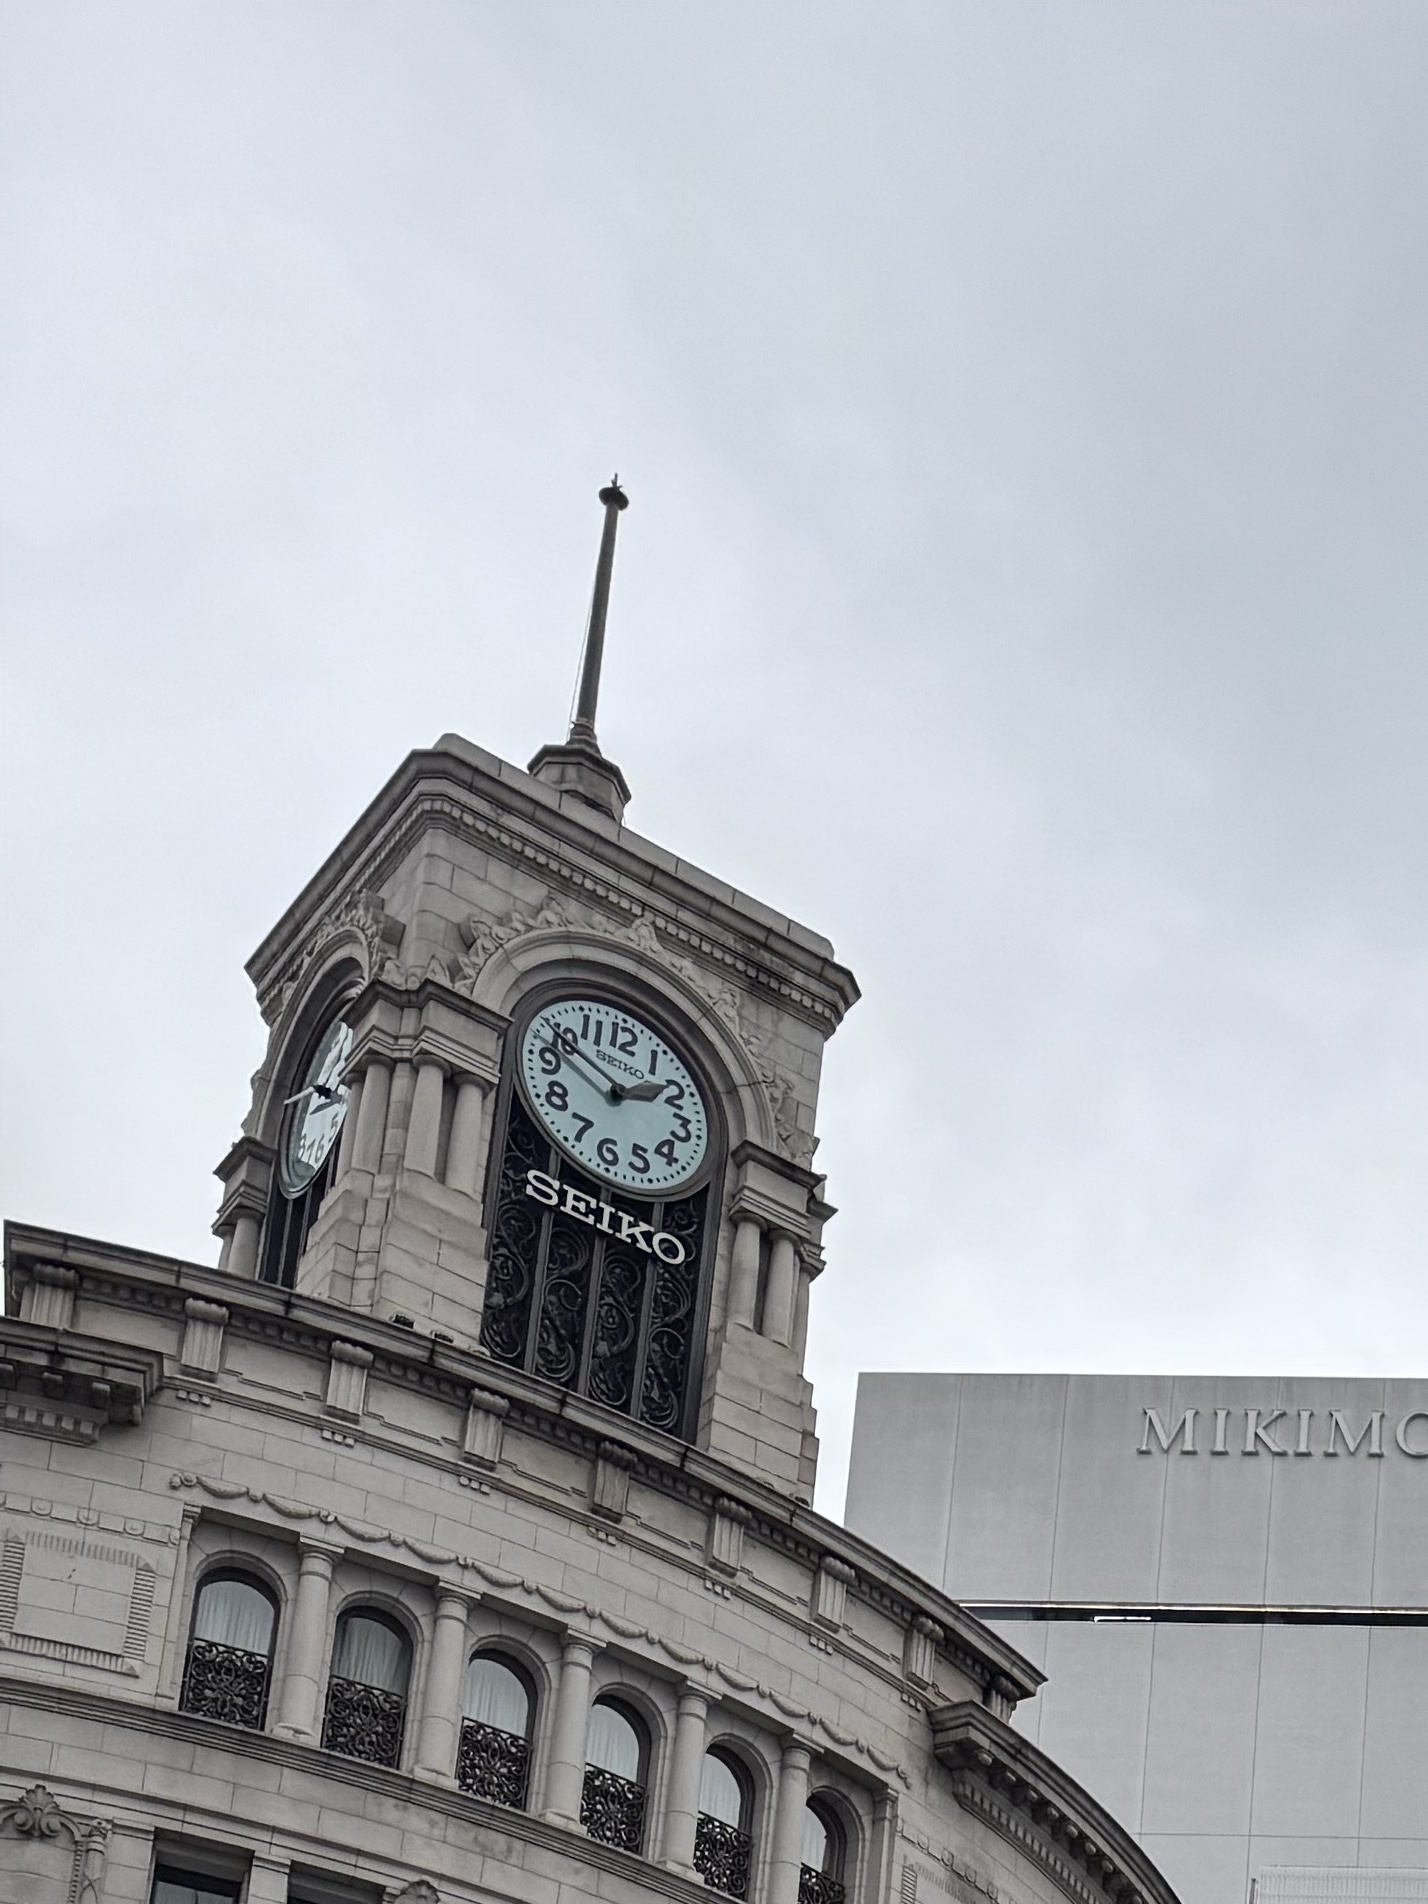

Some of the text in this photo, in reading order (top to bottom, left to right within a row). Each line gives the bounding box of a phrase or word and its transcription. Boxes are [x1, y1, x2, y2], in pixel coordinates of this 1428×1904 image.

[580, 1014, 603, 1048] 11
[609, 1021, 639, 1058] 12
[538, 1046, 562, 1076] 9
[595, 1049, 645, 1081] SEIKO
[648, 1049, 658, 1076] 1
[545, 1080, 569, 1112] 8
[664, 1078, 686, 1111] 2
[572, 1112, 595, 1143] 7
[670, 1112, 692, 1143] 3
[596, 1137, 620, 1167] 6
[628, 1142, 651, 1175] 5
[654, 1138, 679, 1168] 4
[525, 1169, 686, 1266] SEIKO
